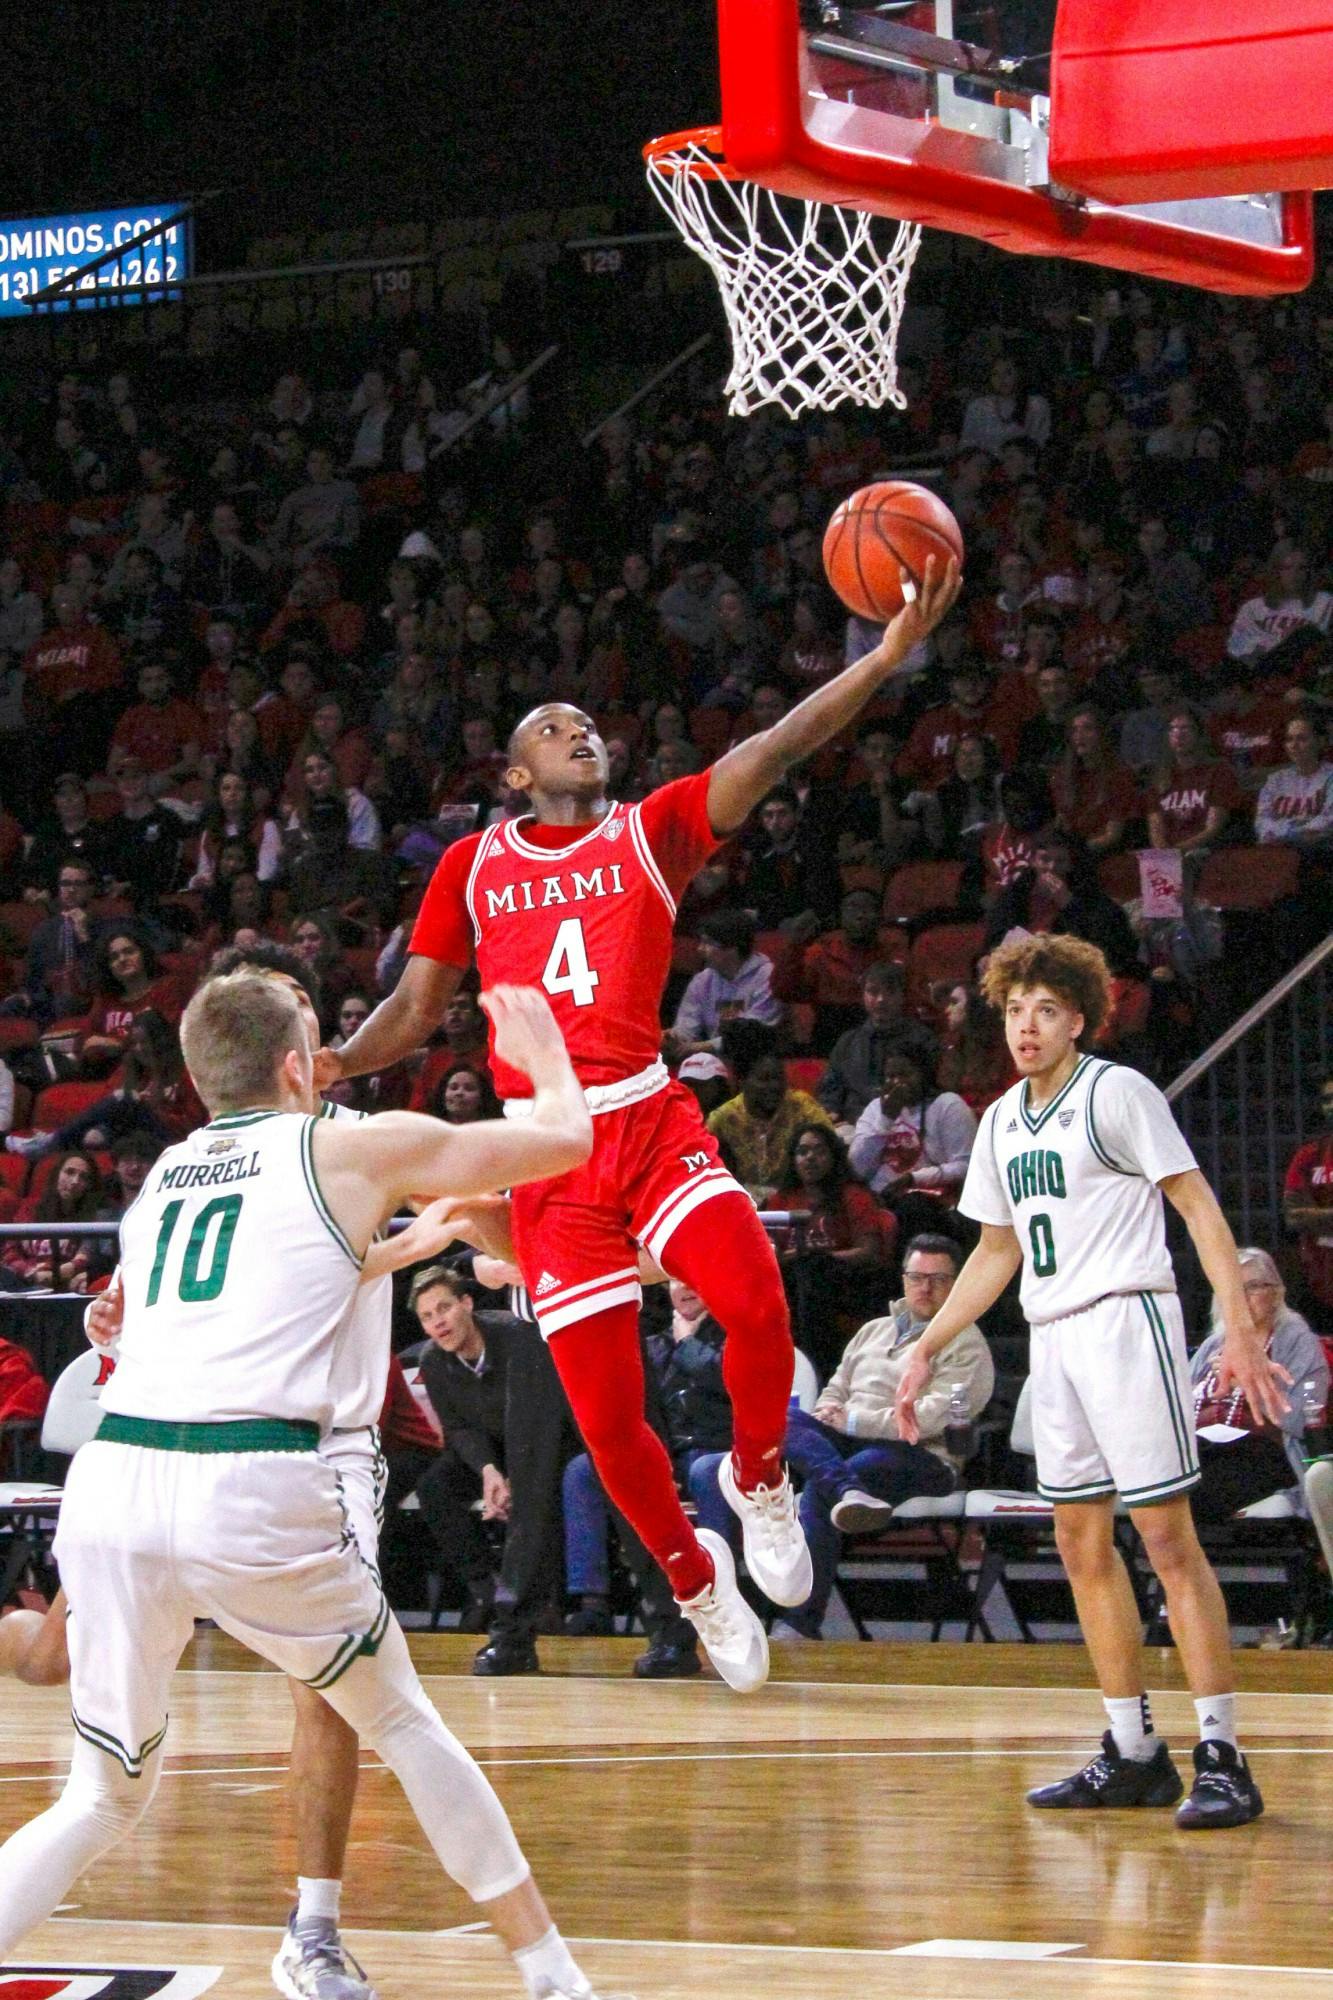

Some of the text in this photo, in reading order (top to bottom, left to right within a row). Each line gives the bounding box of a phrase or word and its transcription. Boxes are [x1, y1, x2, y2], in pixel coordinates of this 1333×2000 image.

[372, 270, 411, 293] 130
[485, 864, 625, 918] MIAMI
[541, 917, 600, 1007] 4
[157, 1150, 262, 1193] MURRELL
[680, 1150, 711, 1174] M
[1007, 1149, 1067, 1207] OHIO
[145, 1193, 243, 1307] 10
[1029, 1213, 1057, 1278] 0
